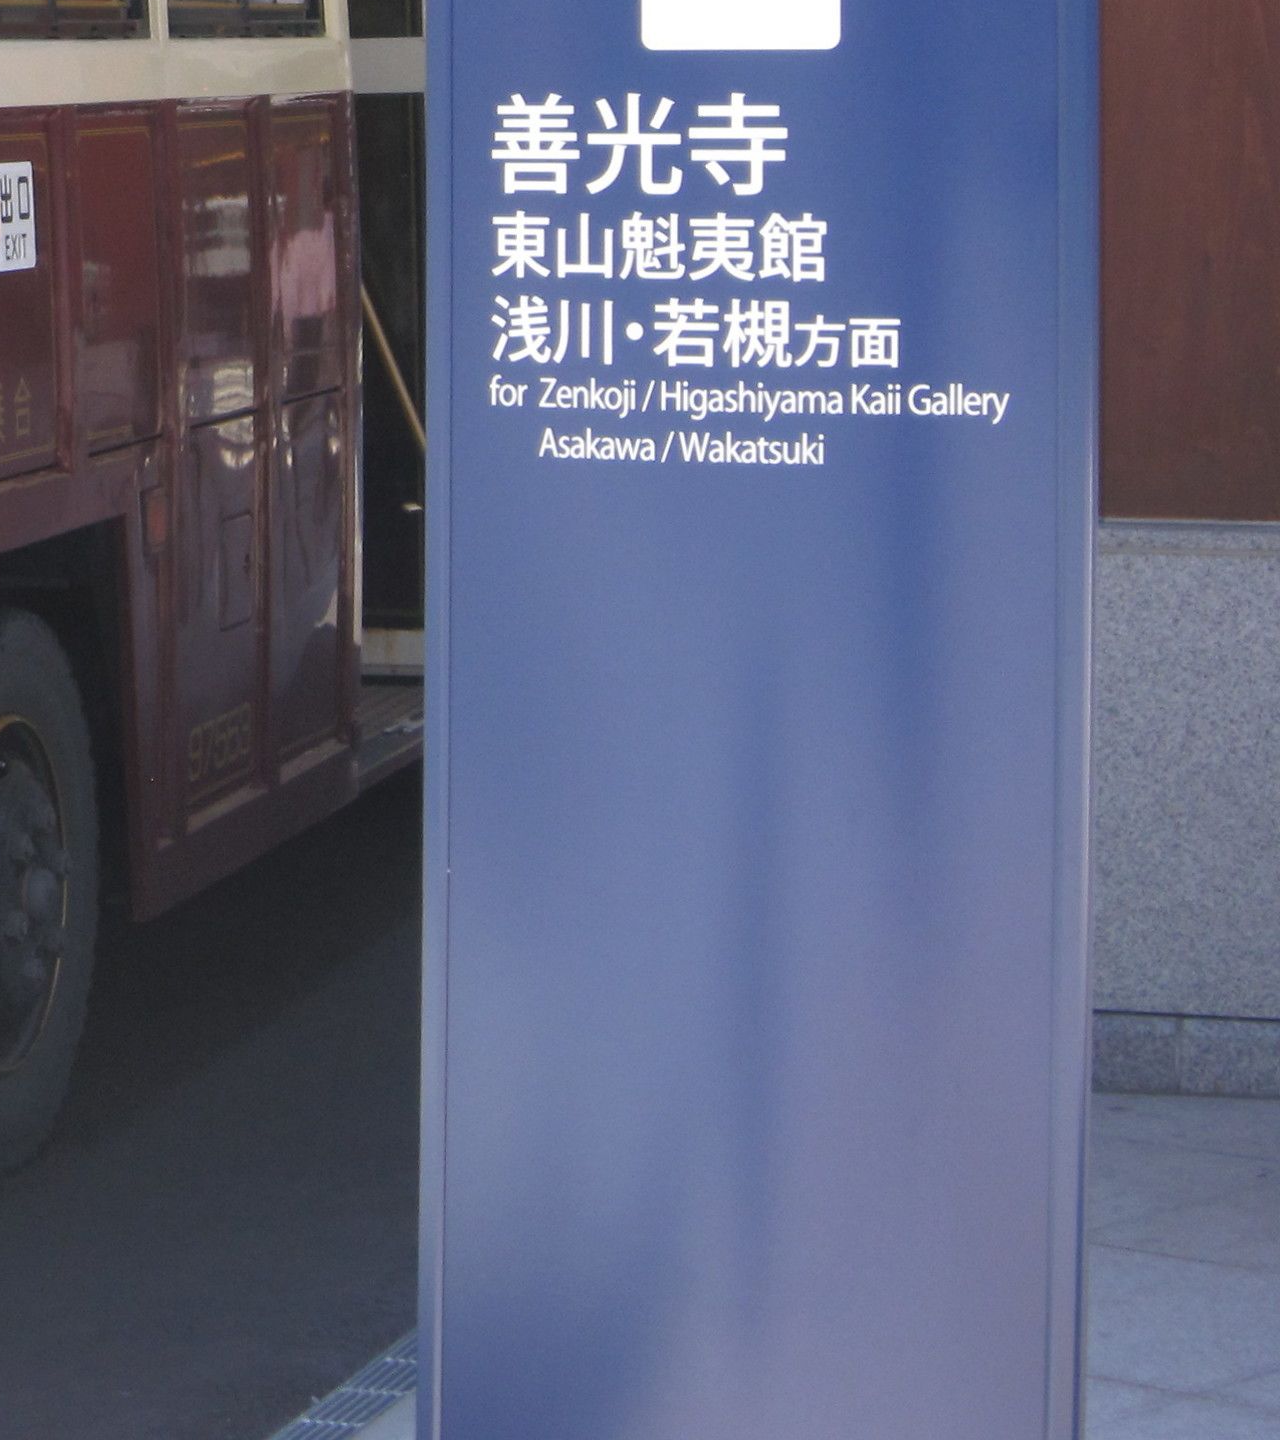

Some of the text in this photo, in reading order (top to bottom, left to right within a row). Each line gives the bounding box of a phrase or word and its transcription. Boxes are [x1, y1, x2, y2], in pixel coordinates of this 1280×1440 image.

[491, 92, 789, 196] 善光寺
[0, 174, 31, 224] 出口
[3, 233, 28, 262] EXIT
[491, 210, 828, 282] 東山魁夷館
[491, 295, 901, 368] 浅川・若槻方面
[489, 375, 528, 407] for
[538, 377, 637, 419] Zenkoji
[660, 380, 844, 423] Higashiyama
[850, 383, 901, 415] Kaii
[907, 384, 1010, 424] Gallery
[539, 428, 656, 460] Asakawa
[678, 431, 825, 465] Wakatsuki
